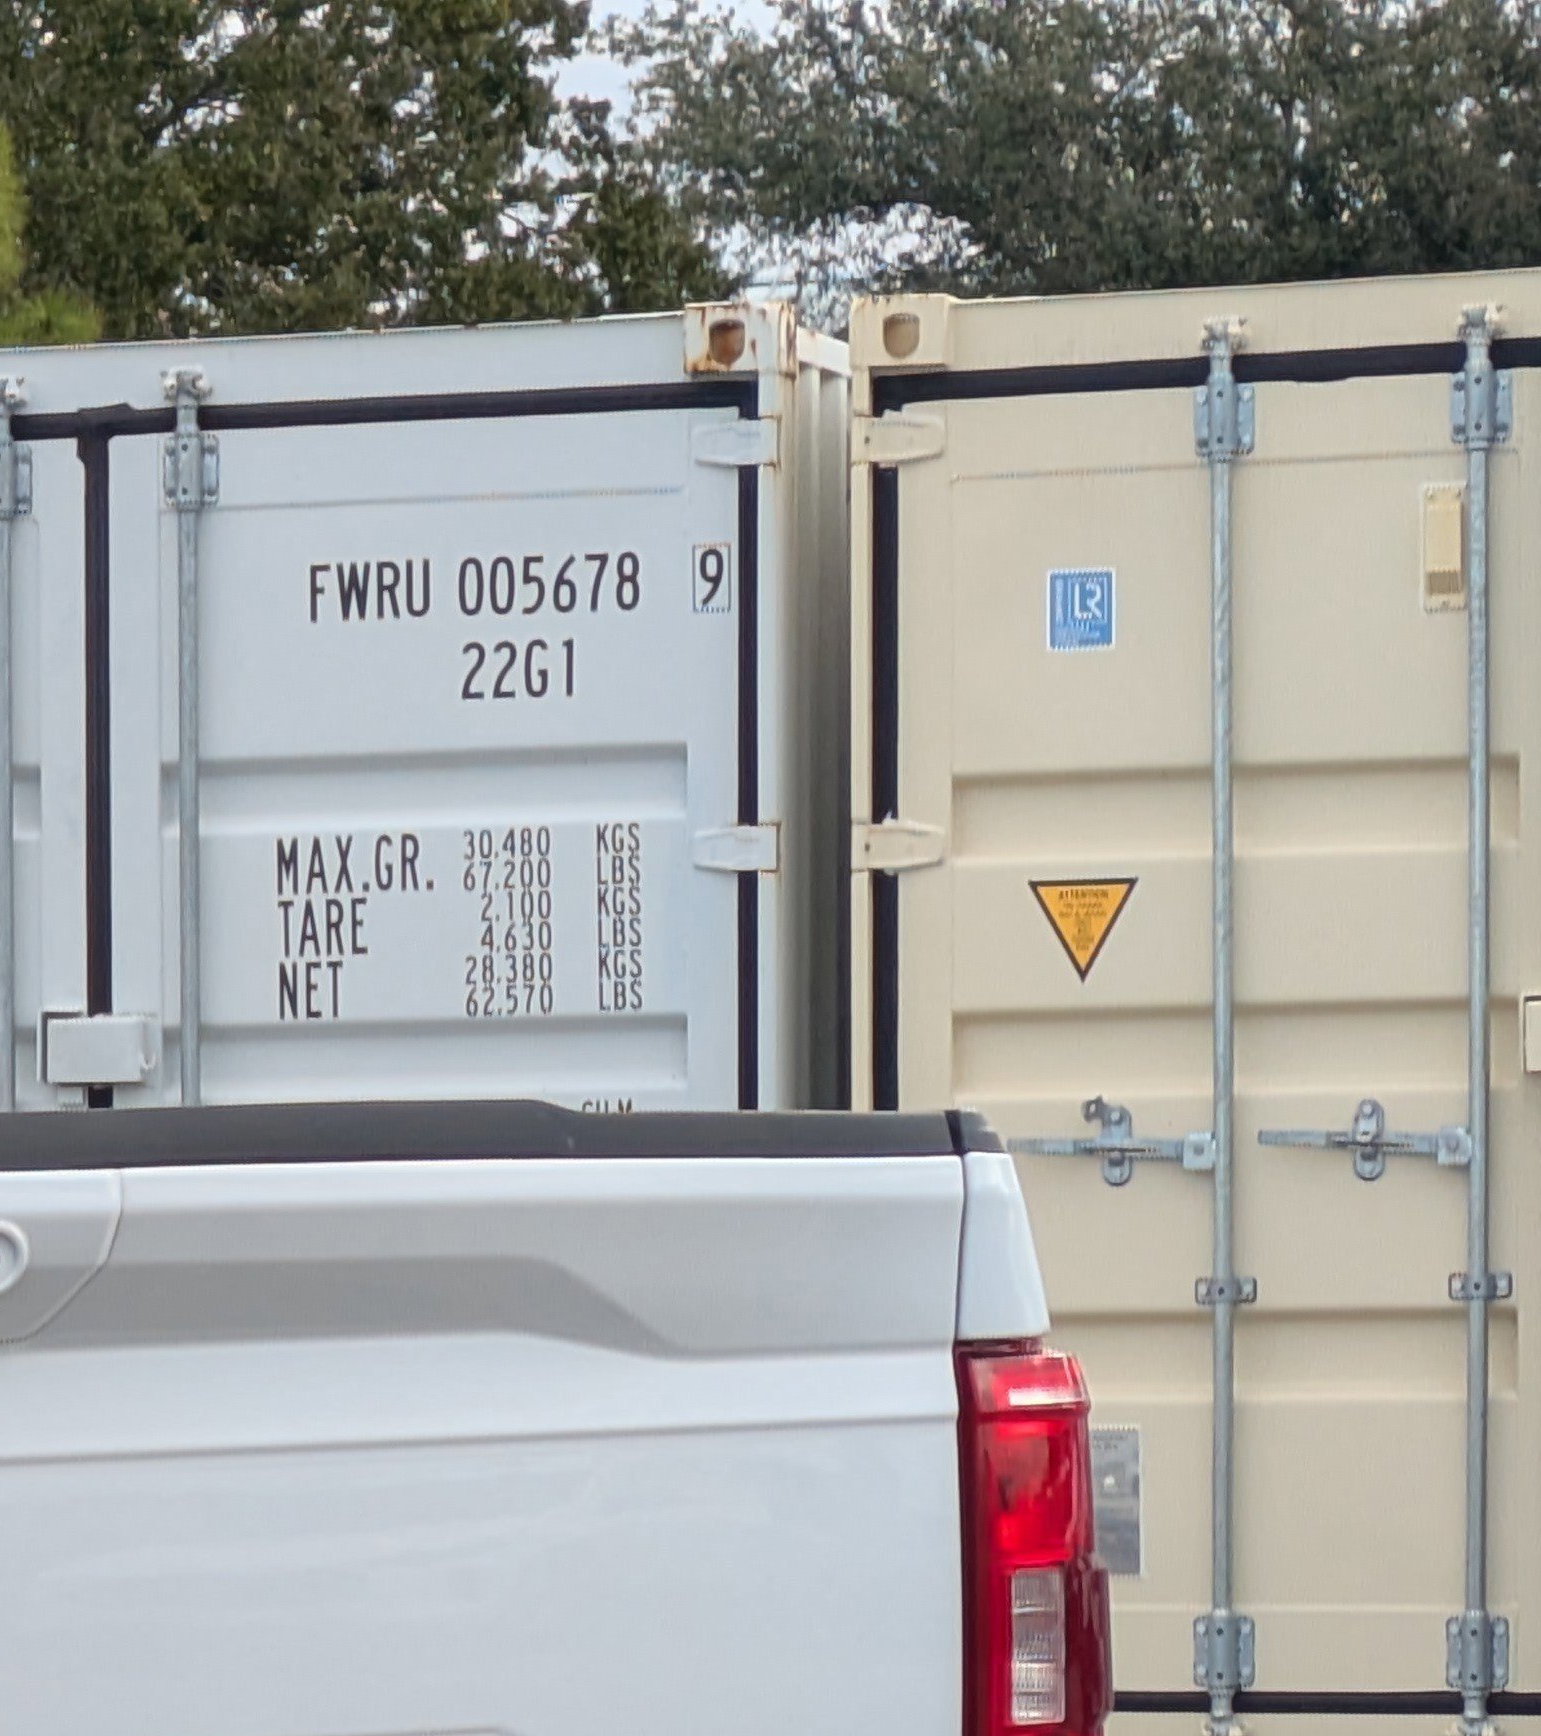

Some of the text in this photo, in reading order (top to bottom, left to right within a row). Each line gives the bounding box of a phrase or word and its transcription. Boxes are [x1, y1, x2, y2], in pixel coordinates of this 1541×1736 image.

[310, 549, 724, 622] FWRU 005678 9
[461, 639, 575, 699] 22G1
[276, 823, 640, 895] MAX.GR. 30.480 KGS
[463, 855, 640, 891] 67.200 LBS
[277, 886, 641, 957] TARE 2.100 KGS
[481, 918, 642, 953] 4.630 LBS
[278, 949, 642, 1019] NET 28.380 KGS
[465, 980, 643, 1017] 62.570 LBS
